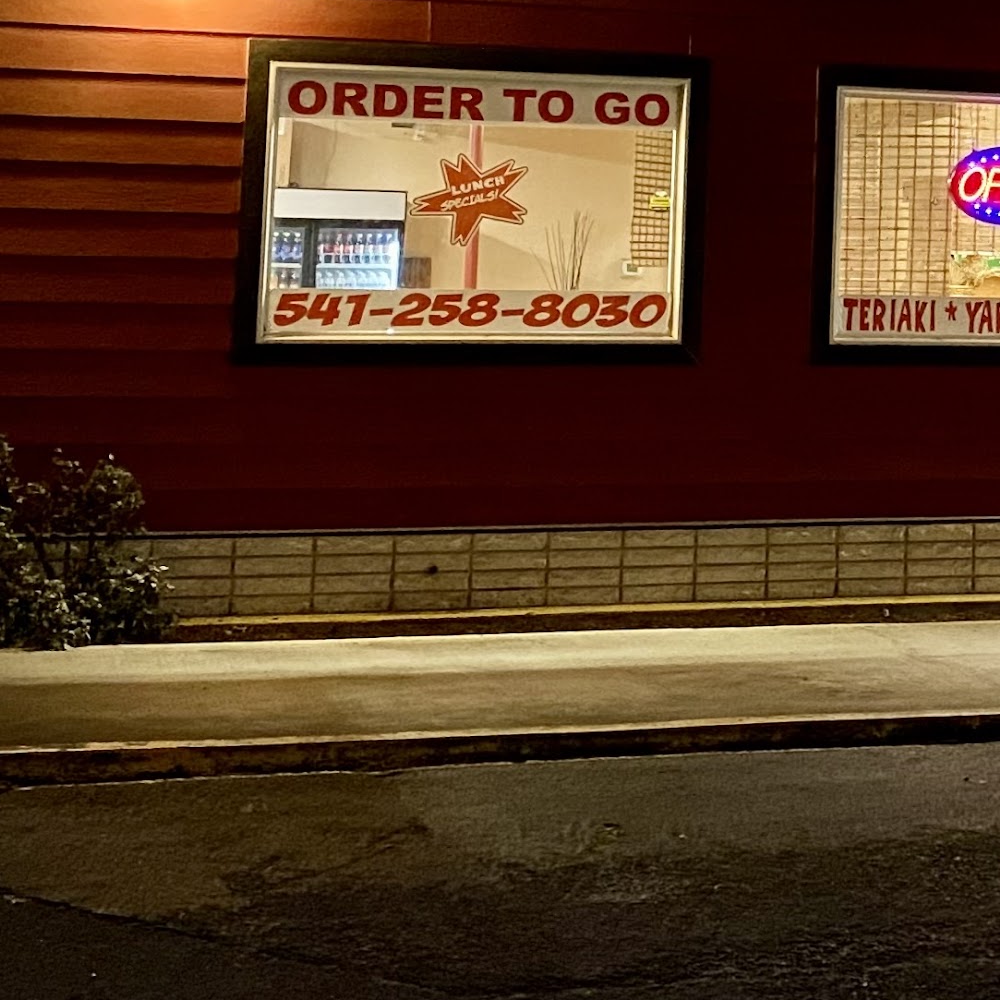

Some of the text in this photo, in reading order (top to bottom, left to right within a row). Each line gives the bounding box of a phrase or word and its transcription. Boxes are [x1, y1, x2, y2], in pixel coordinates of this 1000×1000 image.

[287, 80, 671, 126] ORDER TO GO
[440, 189, 499, 211] SPECIALS!
[451, 175, 506, 197] LUNCH
[273, 292, 667, 328] 541-258-8030
[843, 298, 936, 332] TERIAKI
